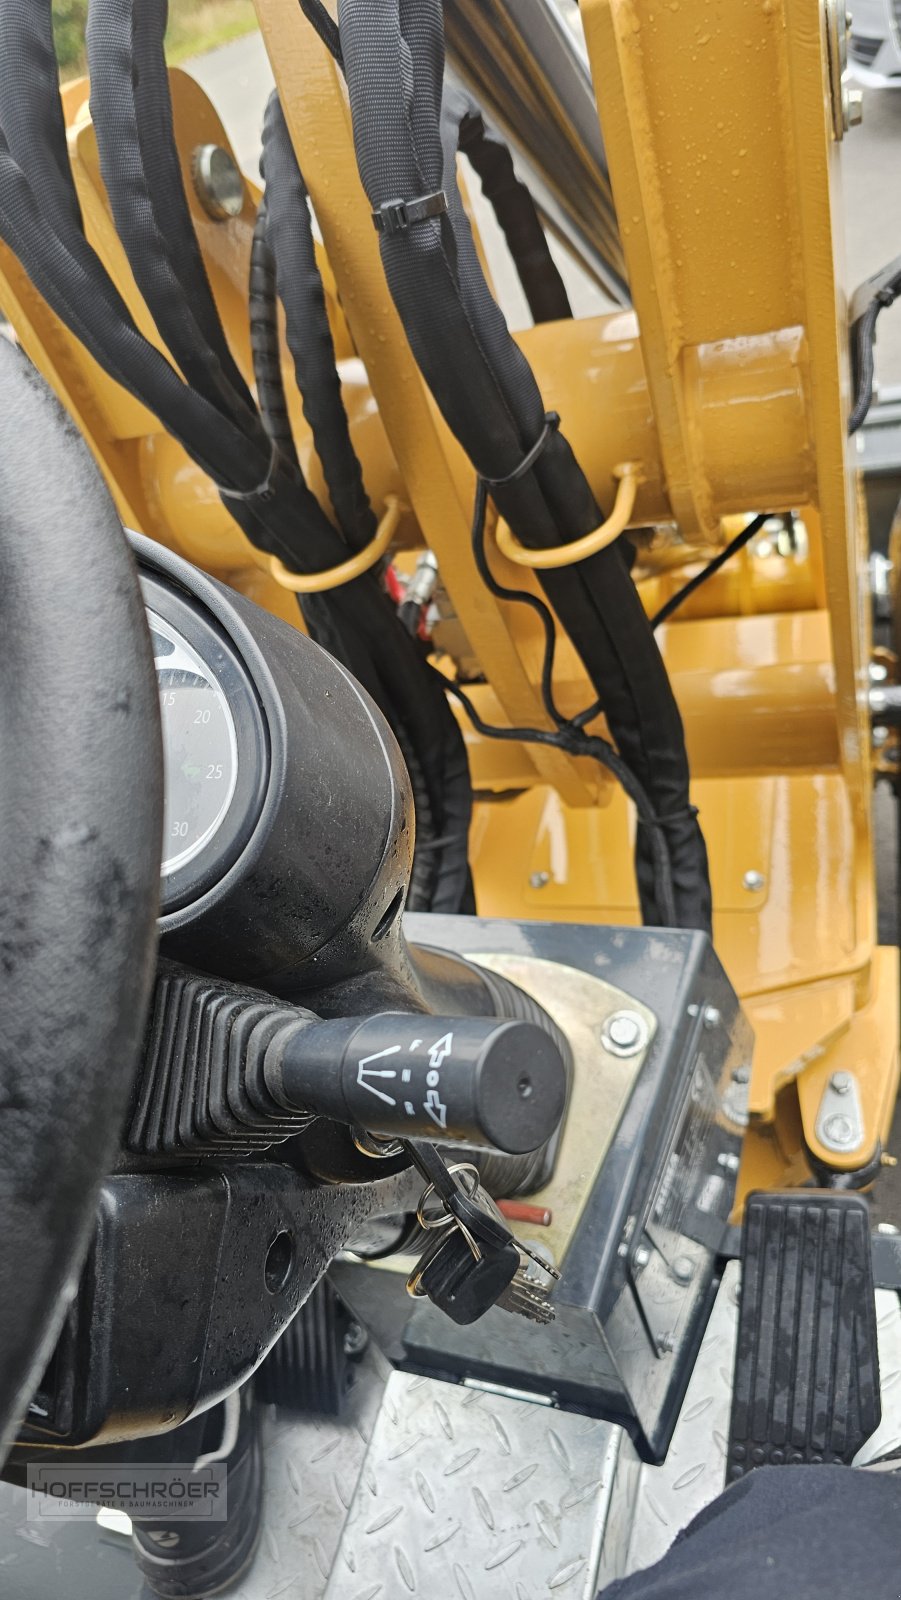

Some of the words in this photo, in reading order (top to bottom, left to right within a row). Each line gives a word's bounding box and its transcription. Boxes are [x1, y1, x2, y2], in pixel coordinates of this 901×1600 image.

[160, 692, 176, 706] 15
[193, 709, 211, 724] 20
[206, 764, 223, 779] 25
[171, 821, 189, 836] 30
